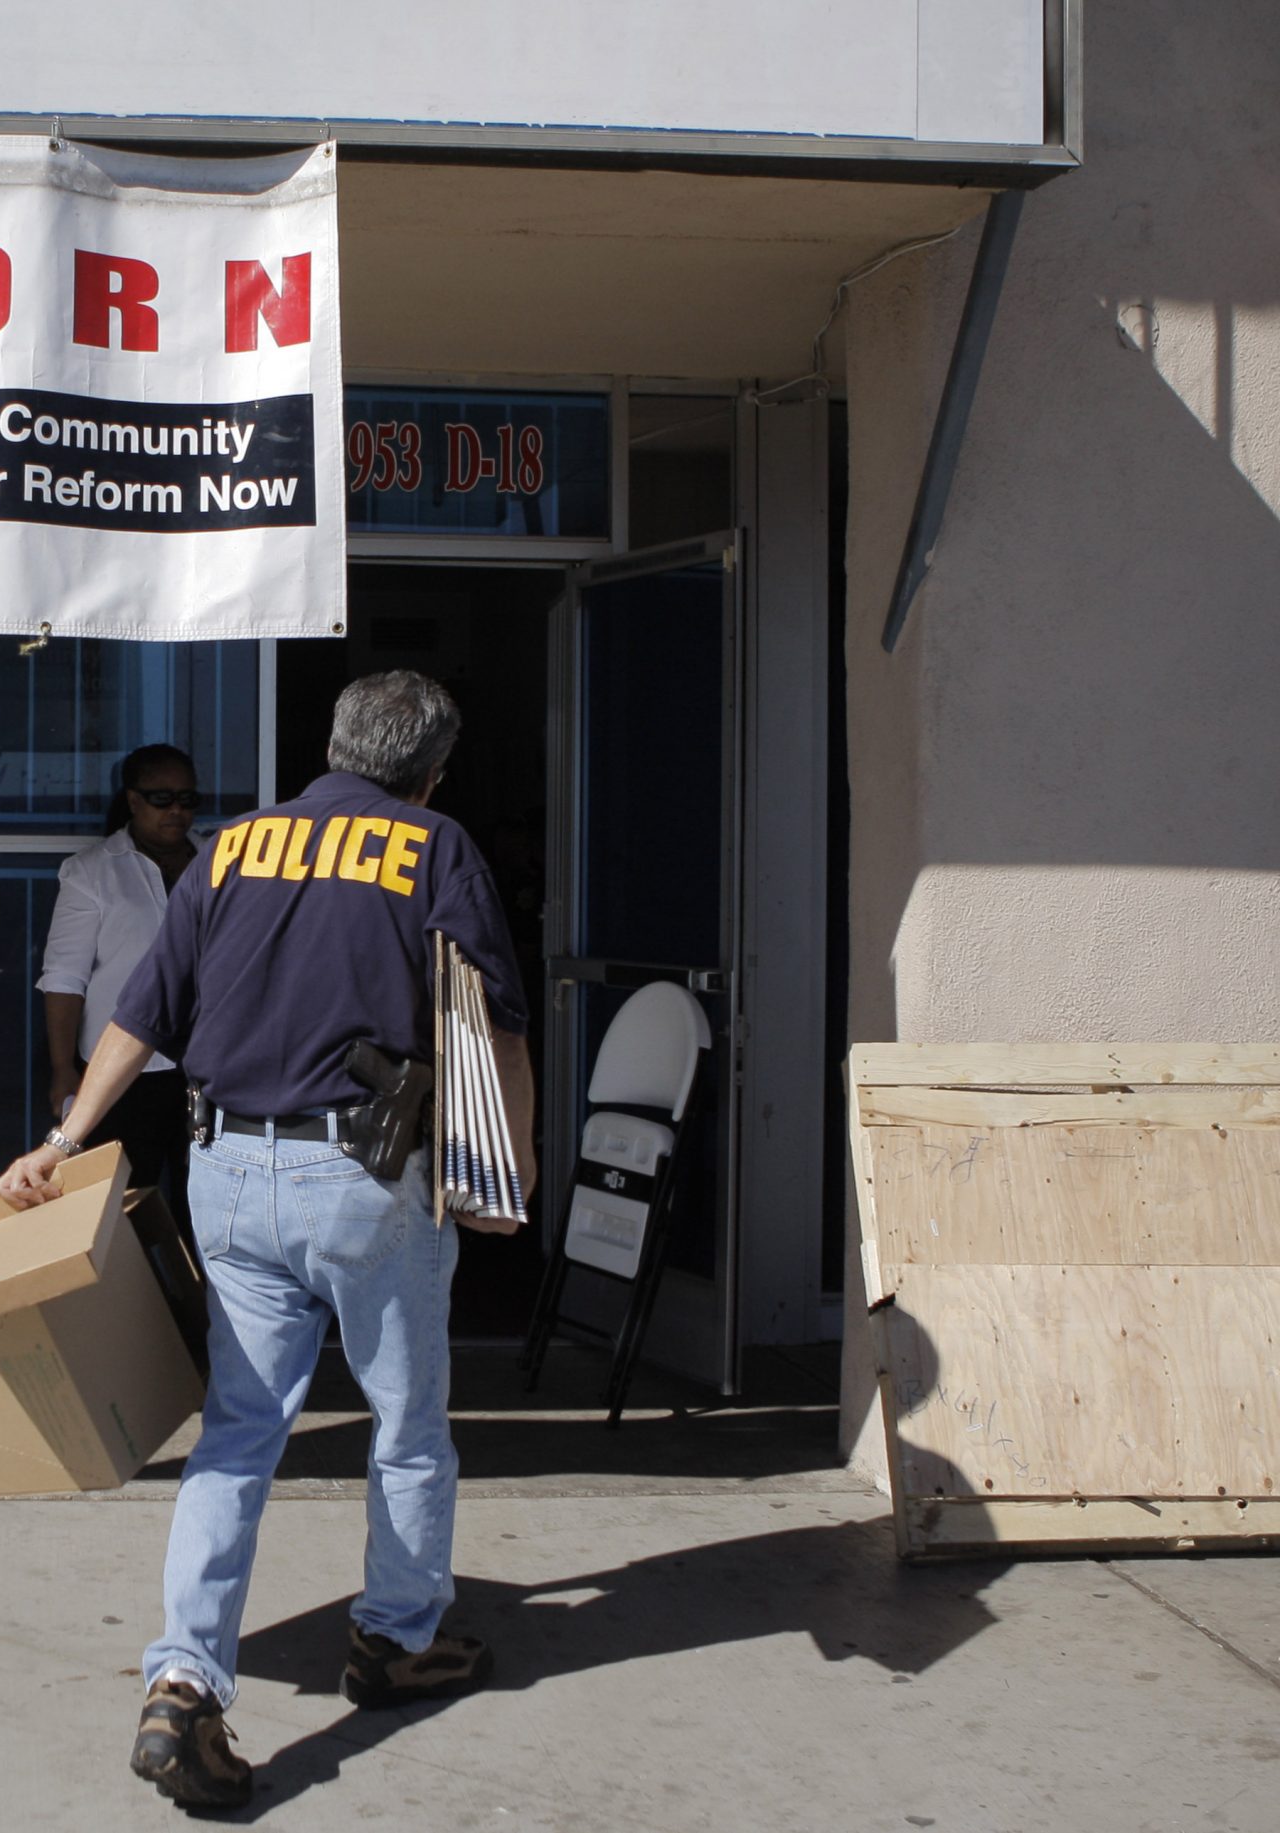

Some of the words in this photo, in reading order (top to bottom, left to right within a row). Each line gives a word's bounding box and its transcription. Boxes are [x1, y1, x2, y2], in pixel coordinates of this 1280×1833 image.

[23, 463, 183, 514] Reform
[200, 475, 298, 513] Now
[444, 423, 543, 494] D-18
[211, 816, 429, 897] POLICE
